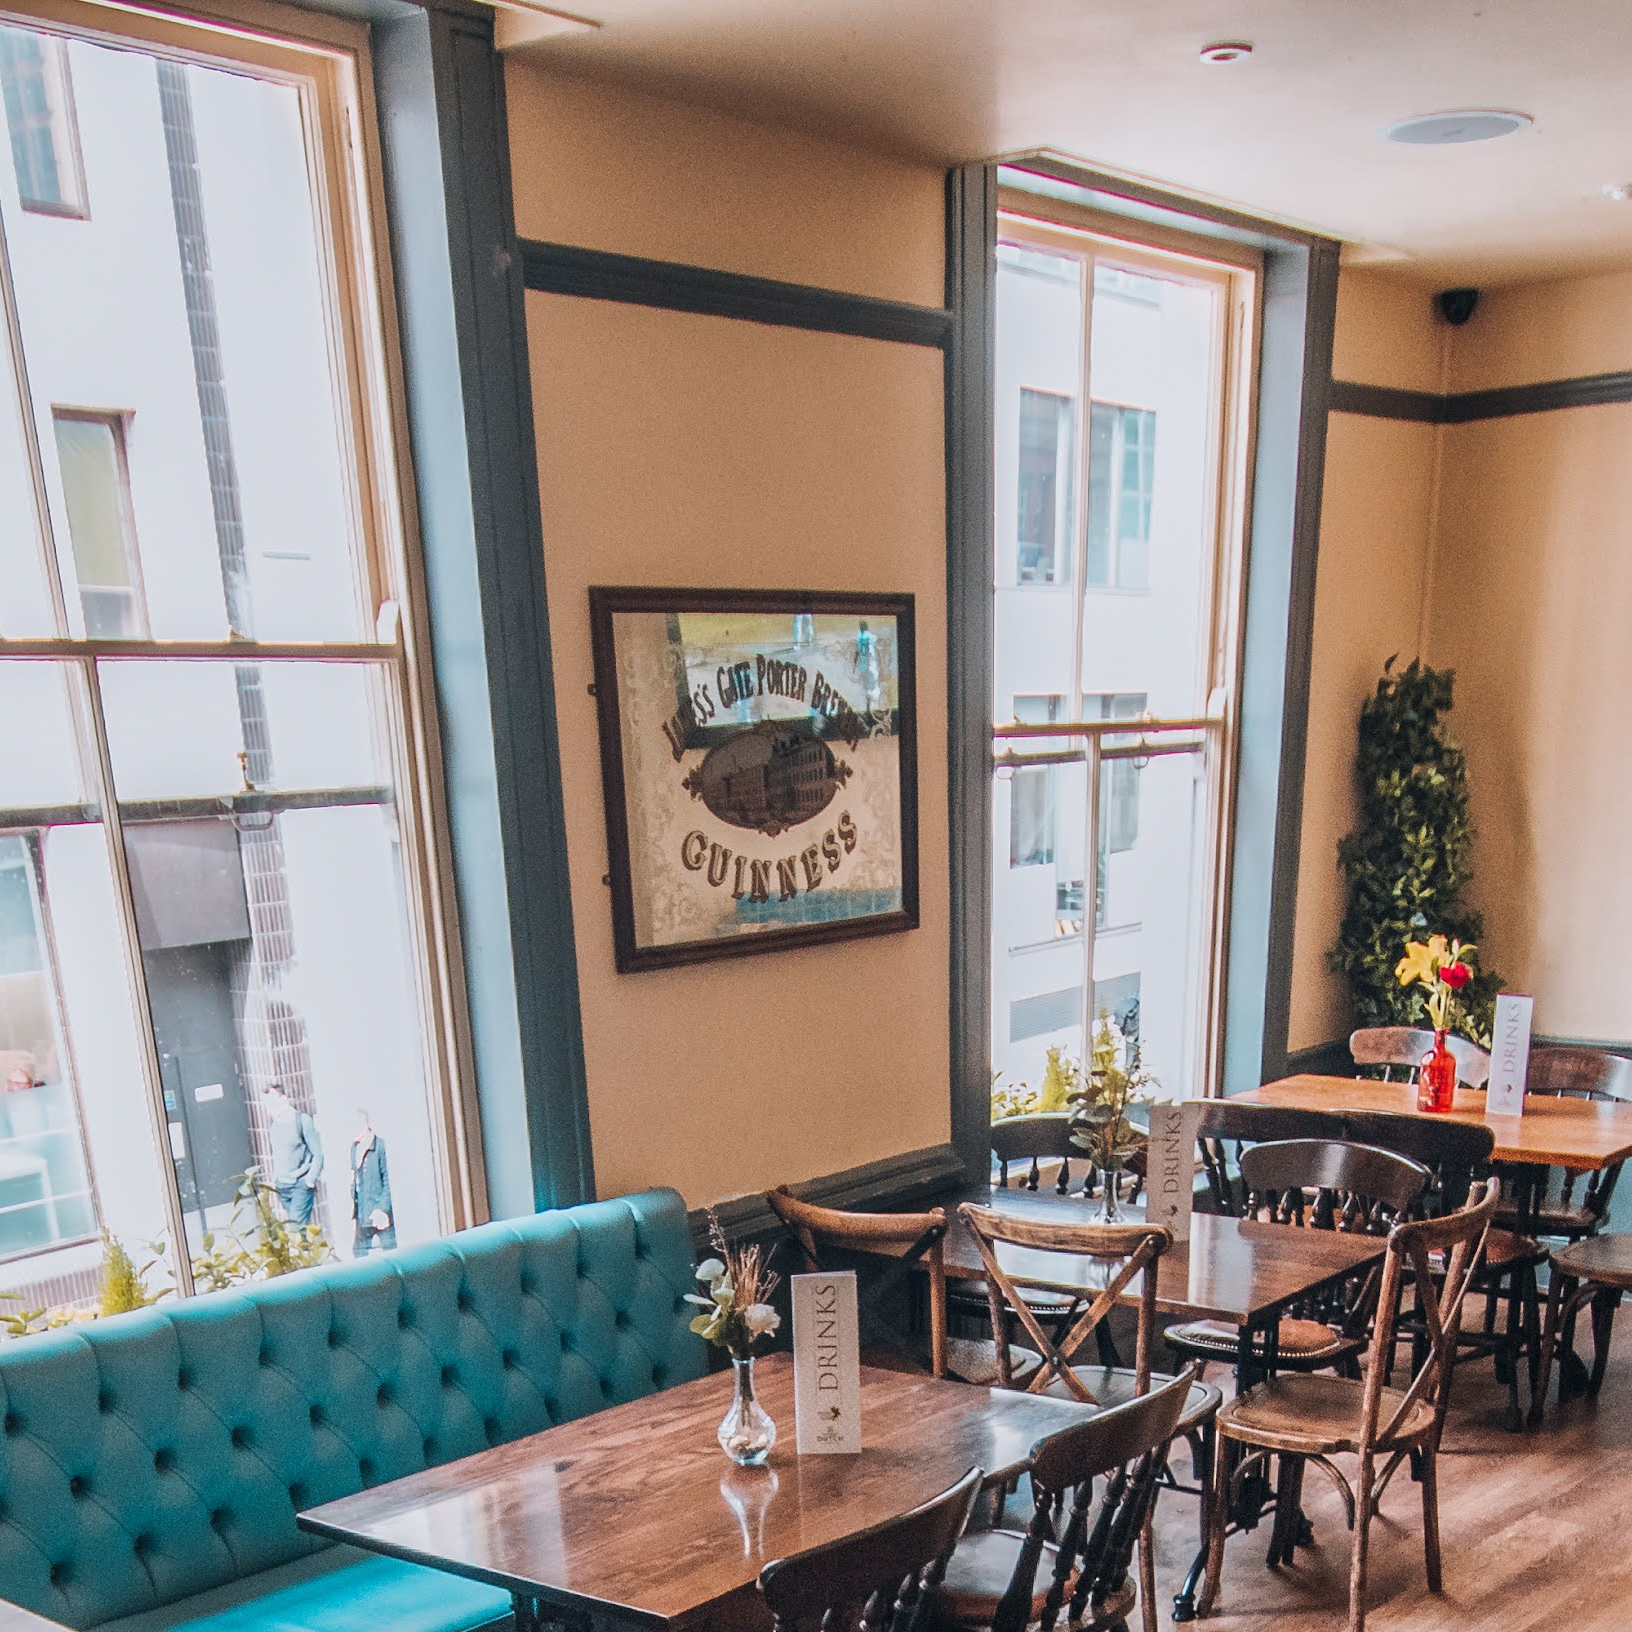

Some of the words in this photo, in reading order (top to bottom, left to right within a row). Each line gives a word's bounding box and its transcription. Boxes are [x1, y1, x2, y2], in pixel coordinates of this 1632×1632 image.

[717, 661, 754, 708] GATE
[756, 653, 808, 703] PORTER
[681, 809, 857, 904] GUINNESS
[1502, 1002, 1521, 1073] DRINKS
[1163, 1110, 1182, 1193] DRINKS
[815, 1284, 839, 1390] DRINKS
